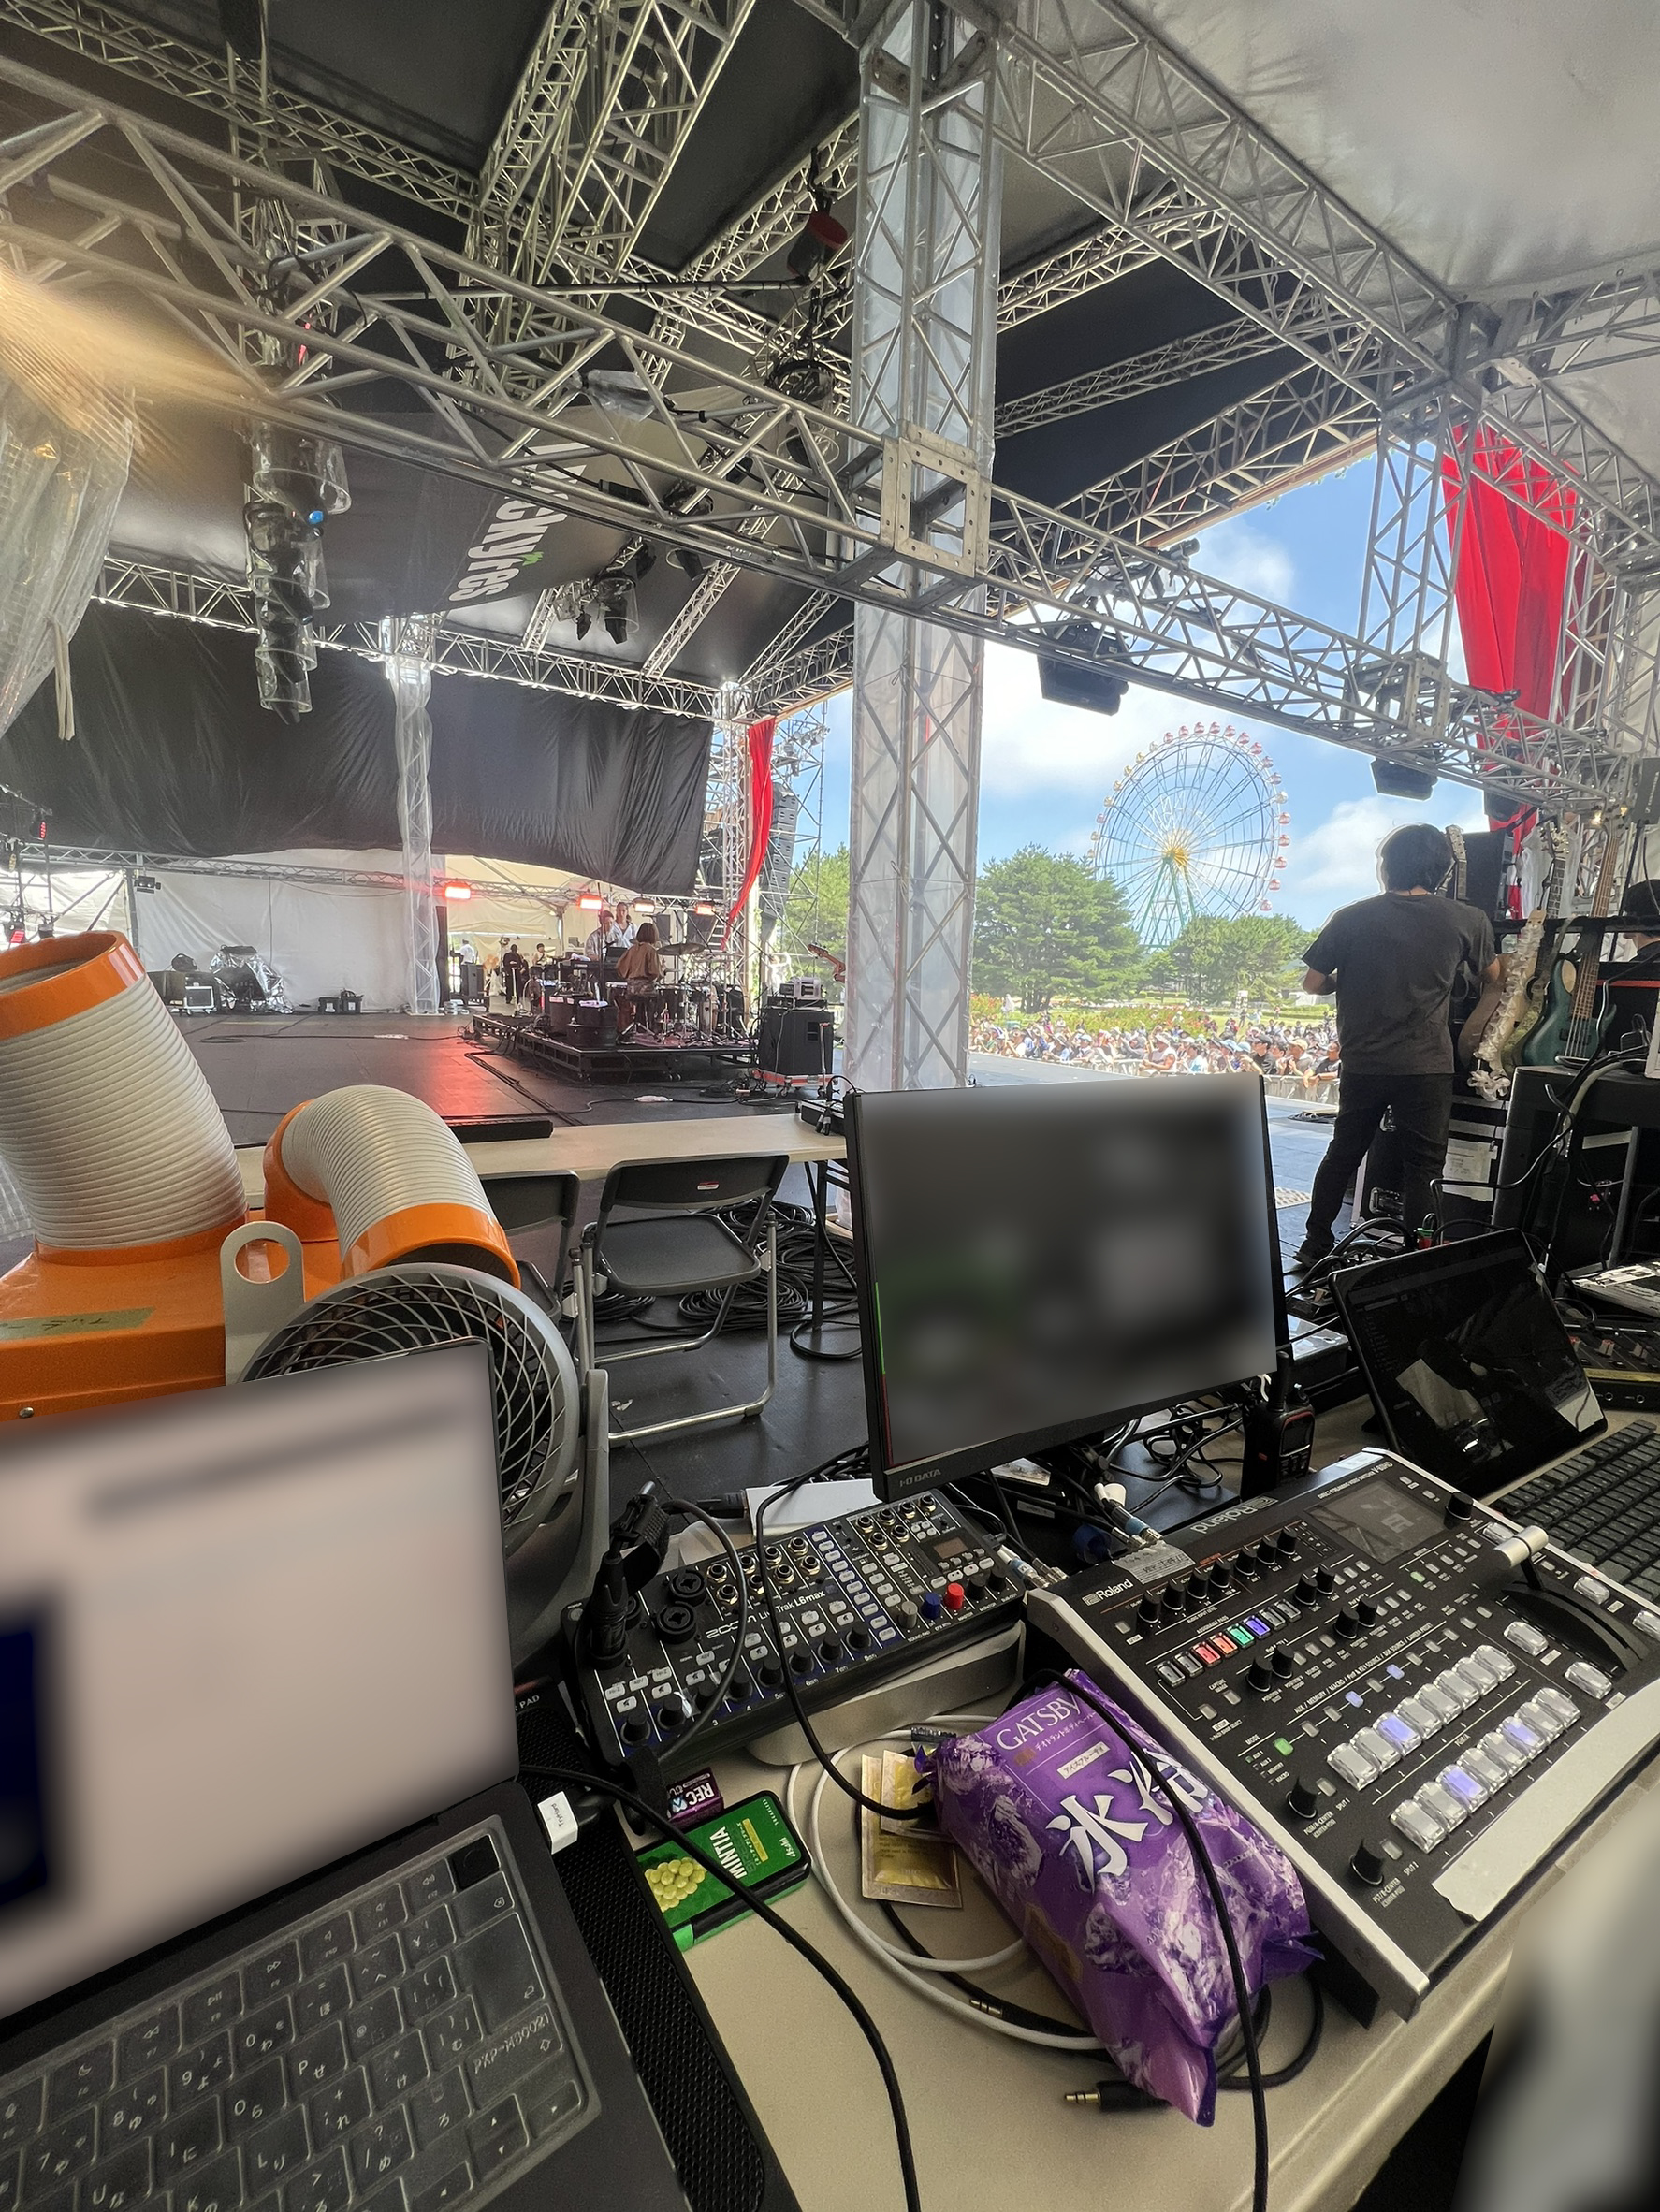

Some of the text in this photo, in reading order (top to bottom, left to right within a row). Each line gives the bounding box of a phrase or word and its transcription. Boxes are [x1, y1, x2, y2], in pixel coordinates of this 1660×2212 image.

[914, 1469, 941, 1483] DATA
[1095, 1578, 1134, 1601] Roland
[758, 1602, 795, 1620] LiTrak
[794, 1591, 826, 1607] L6max
[997, 1691, 1081, 1750] GATSBY
[709, 1826, 748, 1879] MINTIA
[778, 1837, 797, 1857] Asahi
[357, 2025, 367, 2038] @
[299, 2059, 308, 2076] P
[182, 2071, 193, 2086] 9
[113, 2110, 124, 2127] 8
[257, 2153, 268, 2168] L
